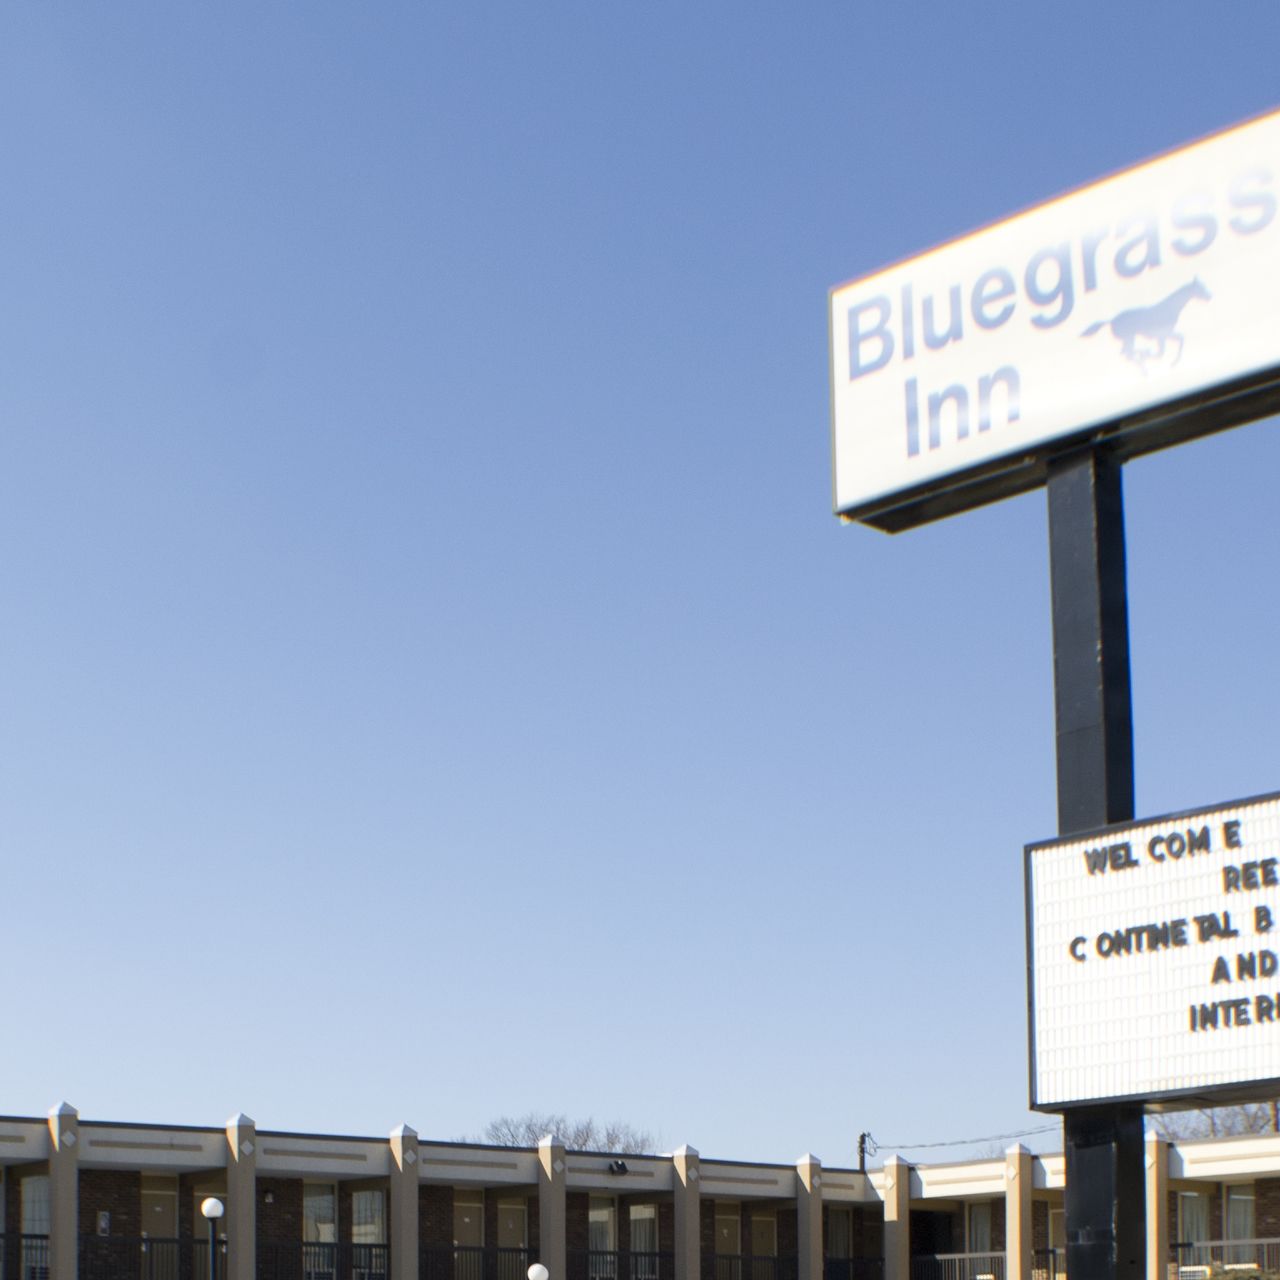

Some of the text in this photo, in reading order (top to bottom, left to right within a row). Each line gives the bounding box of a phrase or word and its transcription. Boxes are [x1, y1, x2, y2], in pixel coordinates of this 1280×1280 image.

[847, 167, 1278, 382] Bluegrass
[904, 364, 1021, 459] Inn
[1223, 857, 1279, 893] REE
[1211, 949, 1279, 984] AND
